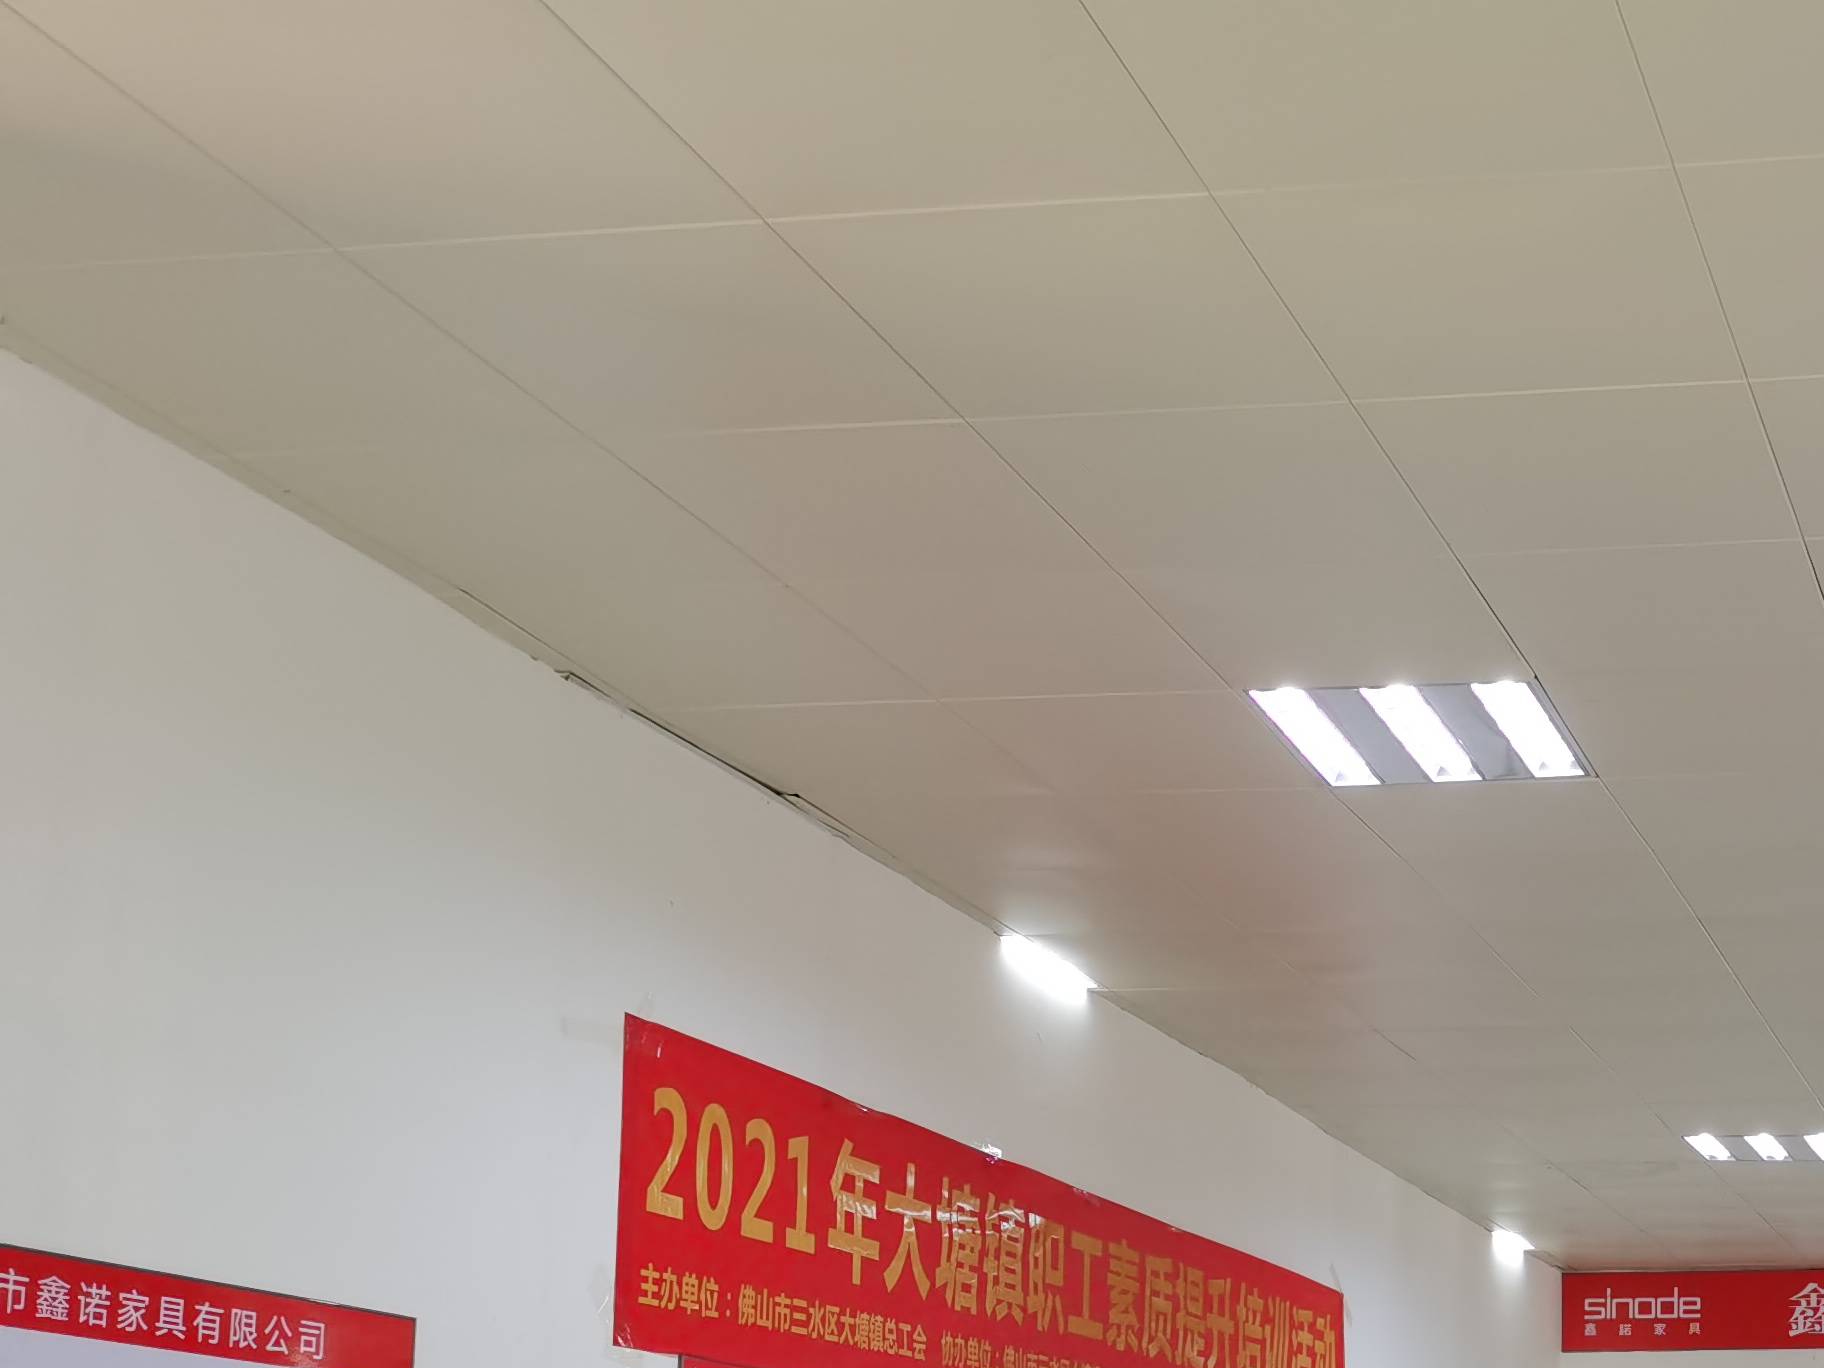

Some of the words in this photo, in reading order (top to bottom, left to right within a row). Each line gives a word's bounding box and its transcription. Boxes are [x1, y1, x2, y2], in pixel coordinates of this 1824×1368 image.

[0, 1268, 326, 1360] 市鑫诺家具有限公司
